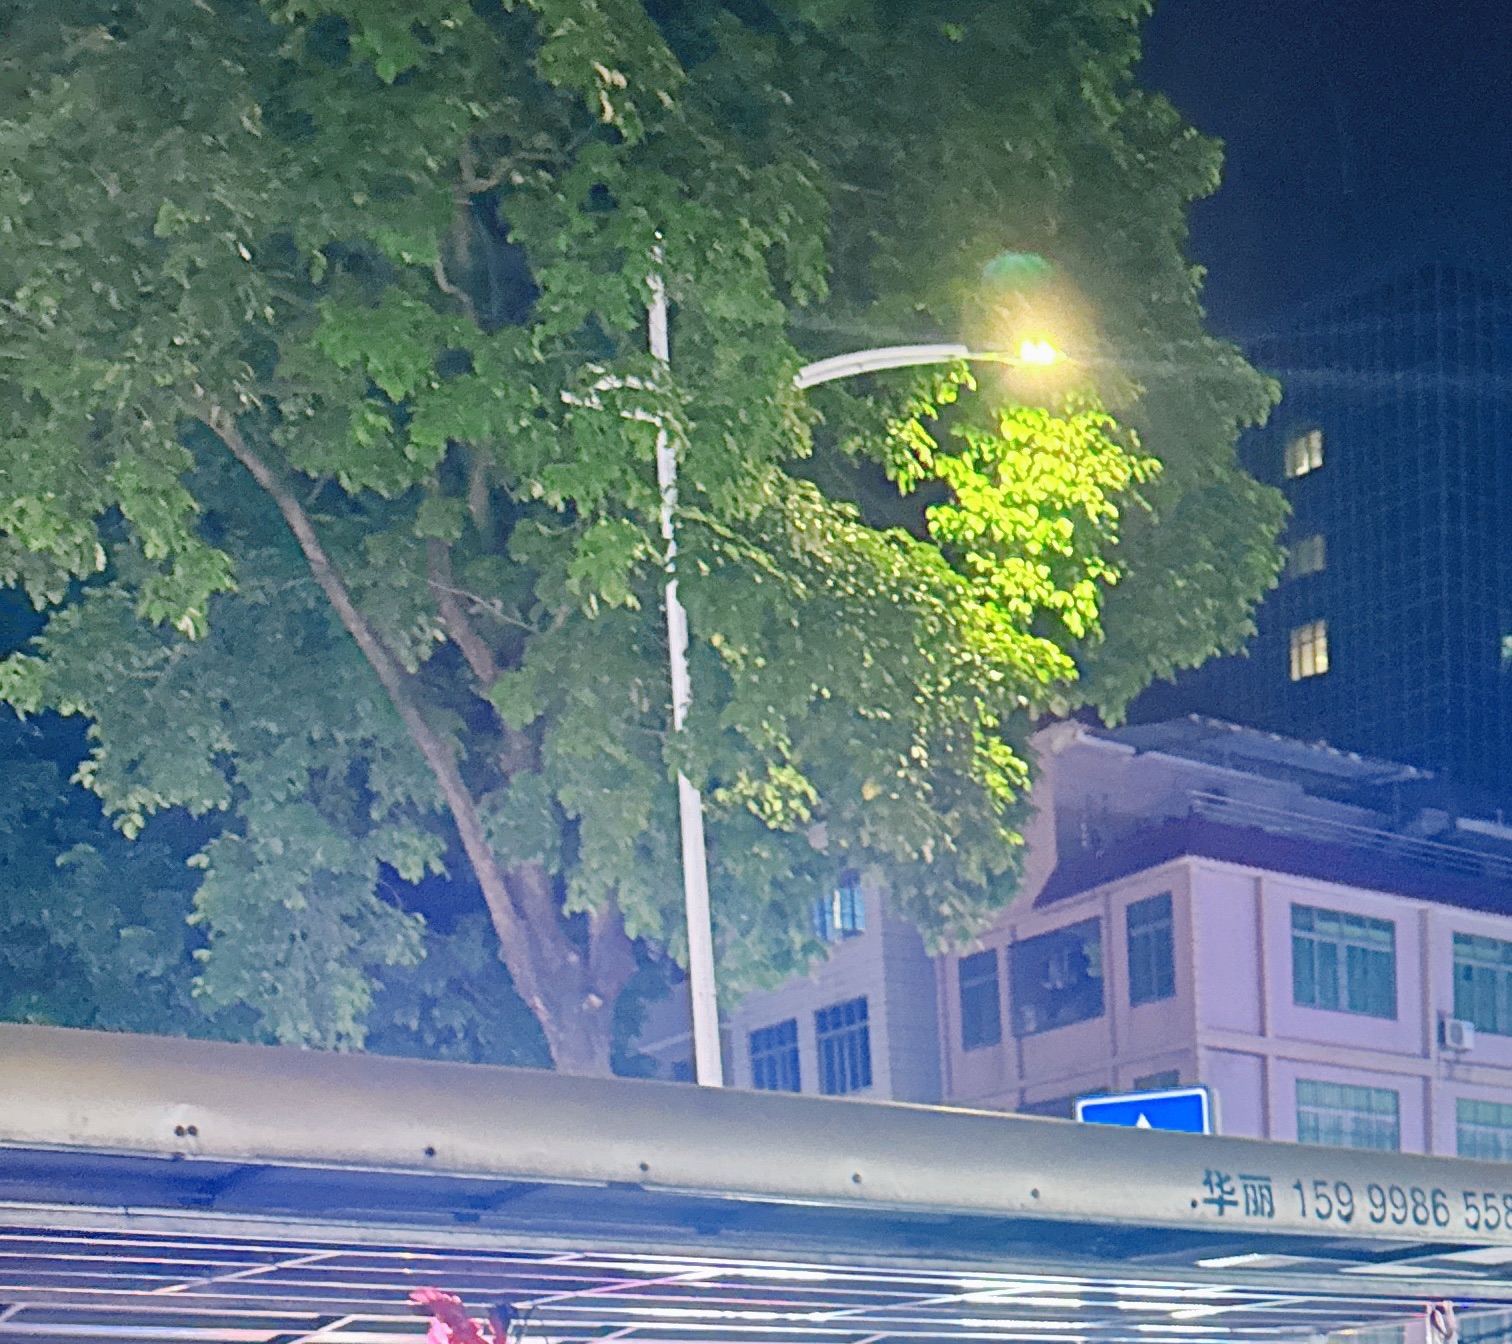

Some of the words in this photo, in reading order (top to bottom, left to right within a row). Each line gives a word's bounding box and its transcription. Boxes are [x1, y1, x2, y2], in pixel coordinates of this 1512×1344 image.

[1203, 1168, 1276, 1219] 华丽
[1293, 1178, 1355, 1223] 159
[1367, 1182, 1451, 1228] 9986
